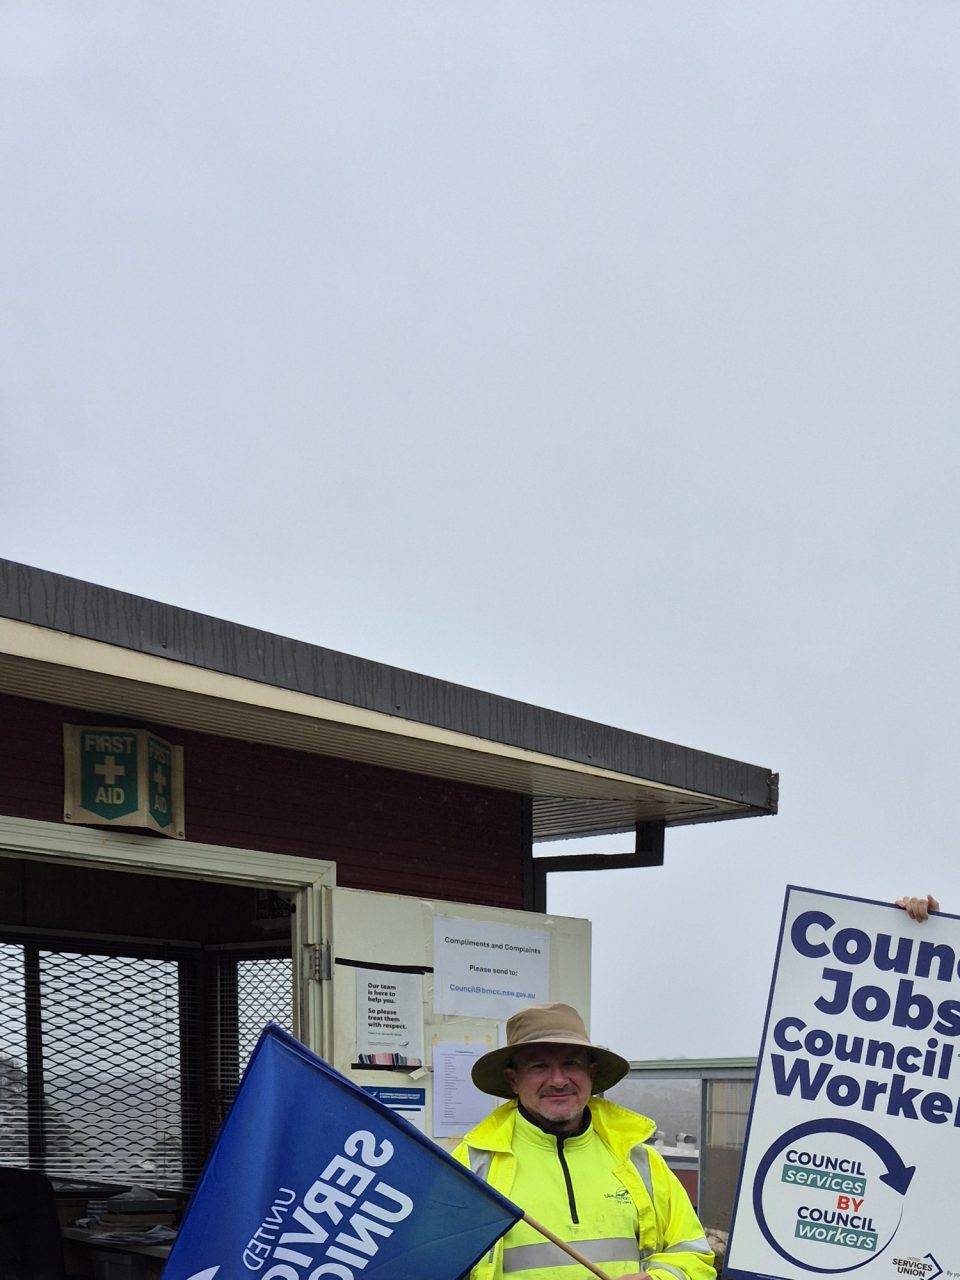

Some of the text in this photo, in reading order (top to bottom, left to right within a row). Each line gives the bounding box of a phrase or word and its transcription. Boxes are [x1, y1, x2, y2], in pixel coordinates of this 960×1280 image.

[84, 733, 134, 754] FIRST
[95, 786, 125, 805] AID
[444, 936, 490, 949] Compliments
[504, 943, 541, 955] Complaints
[469, 964, 492, 974] Please
[373, 989, 388, 997] here
[376, 1008, 397, 1016] please
[773, 1016, 955, 1080] Council
[785, 1149, 866, 1176] COUNCIL
[784, 1168, 864, 1194] services
[836, 1195, 865, 1213] BY
[797, 1205, 876, 1232] COUNCIL
[798, 1223, 875, 1249] workers
[892, 1258, 933, 1272] SERVICES
[897, 1266, 926, 1278] UNION
